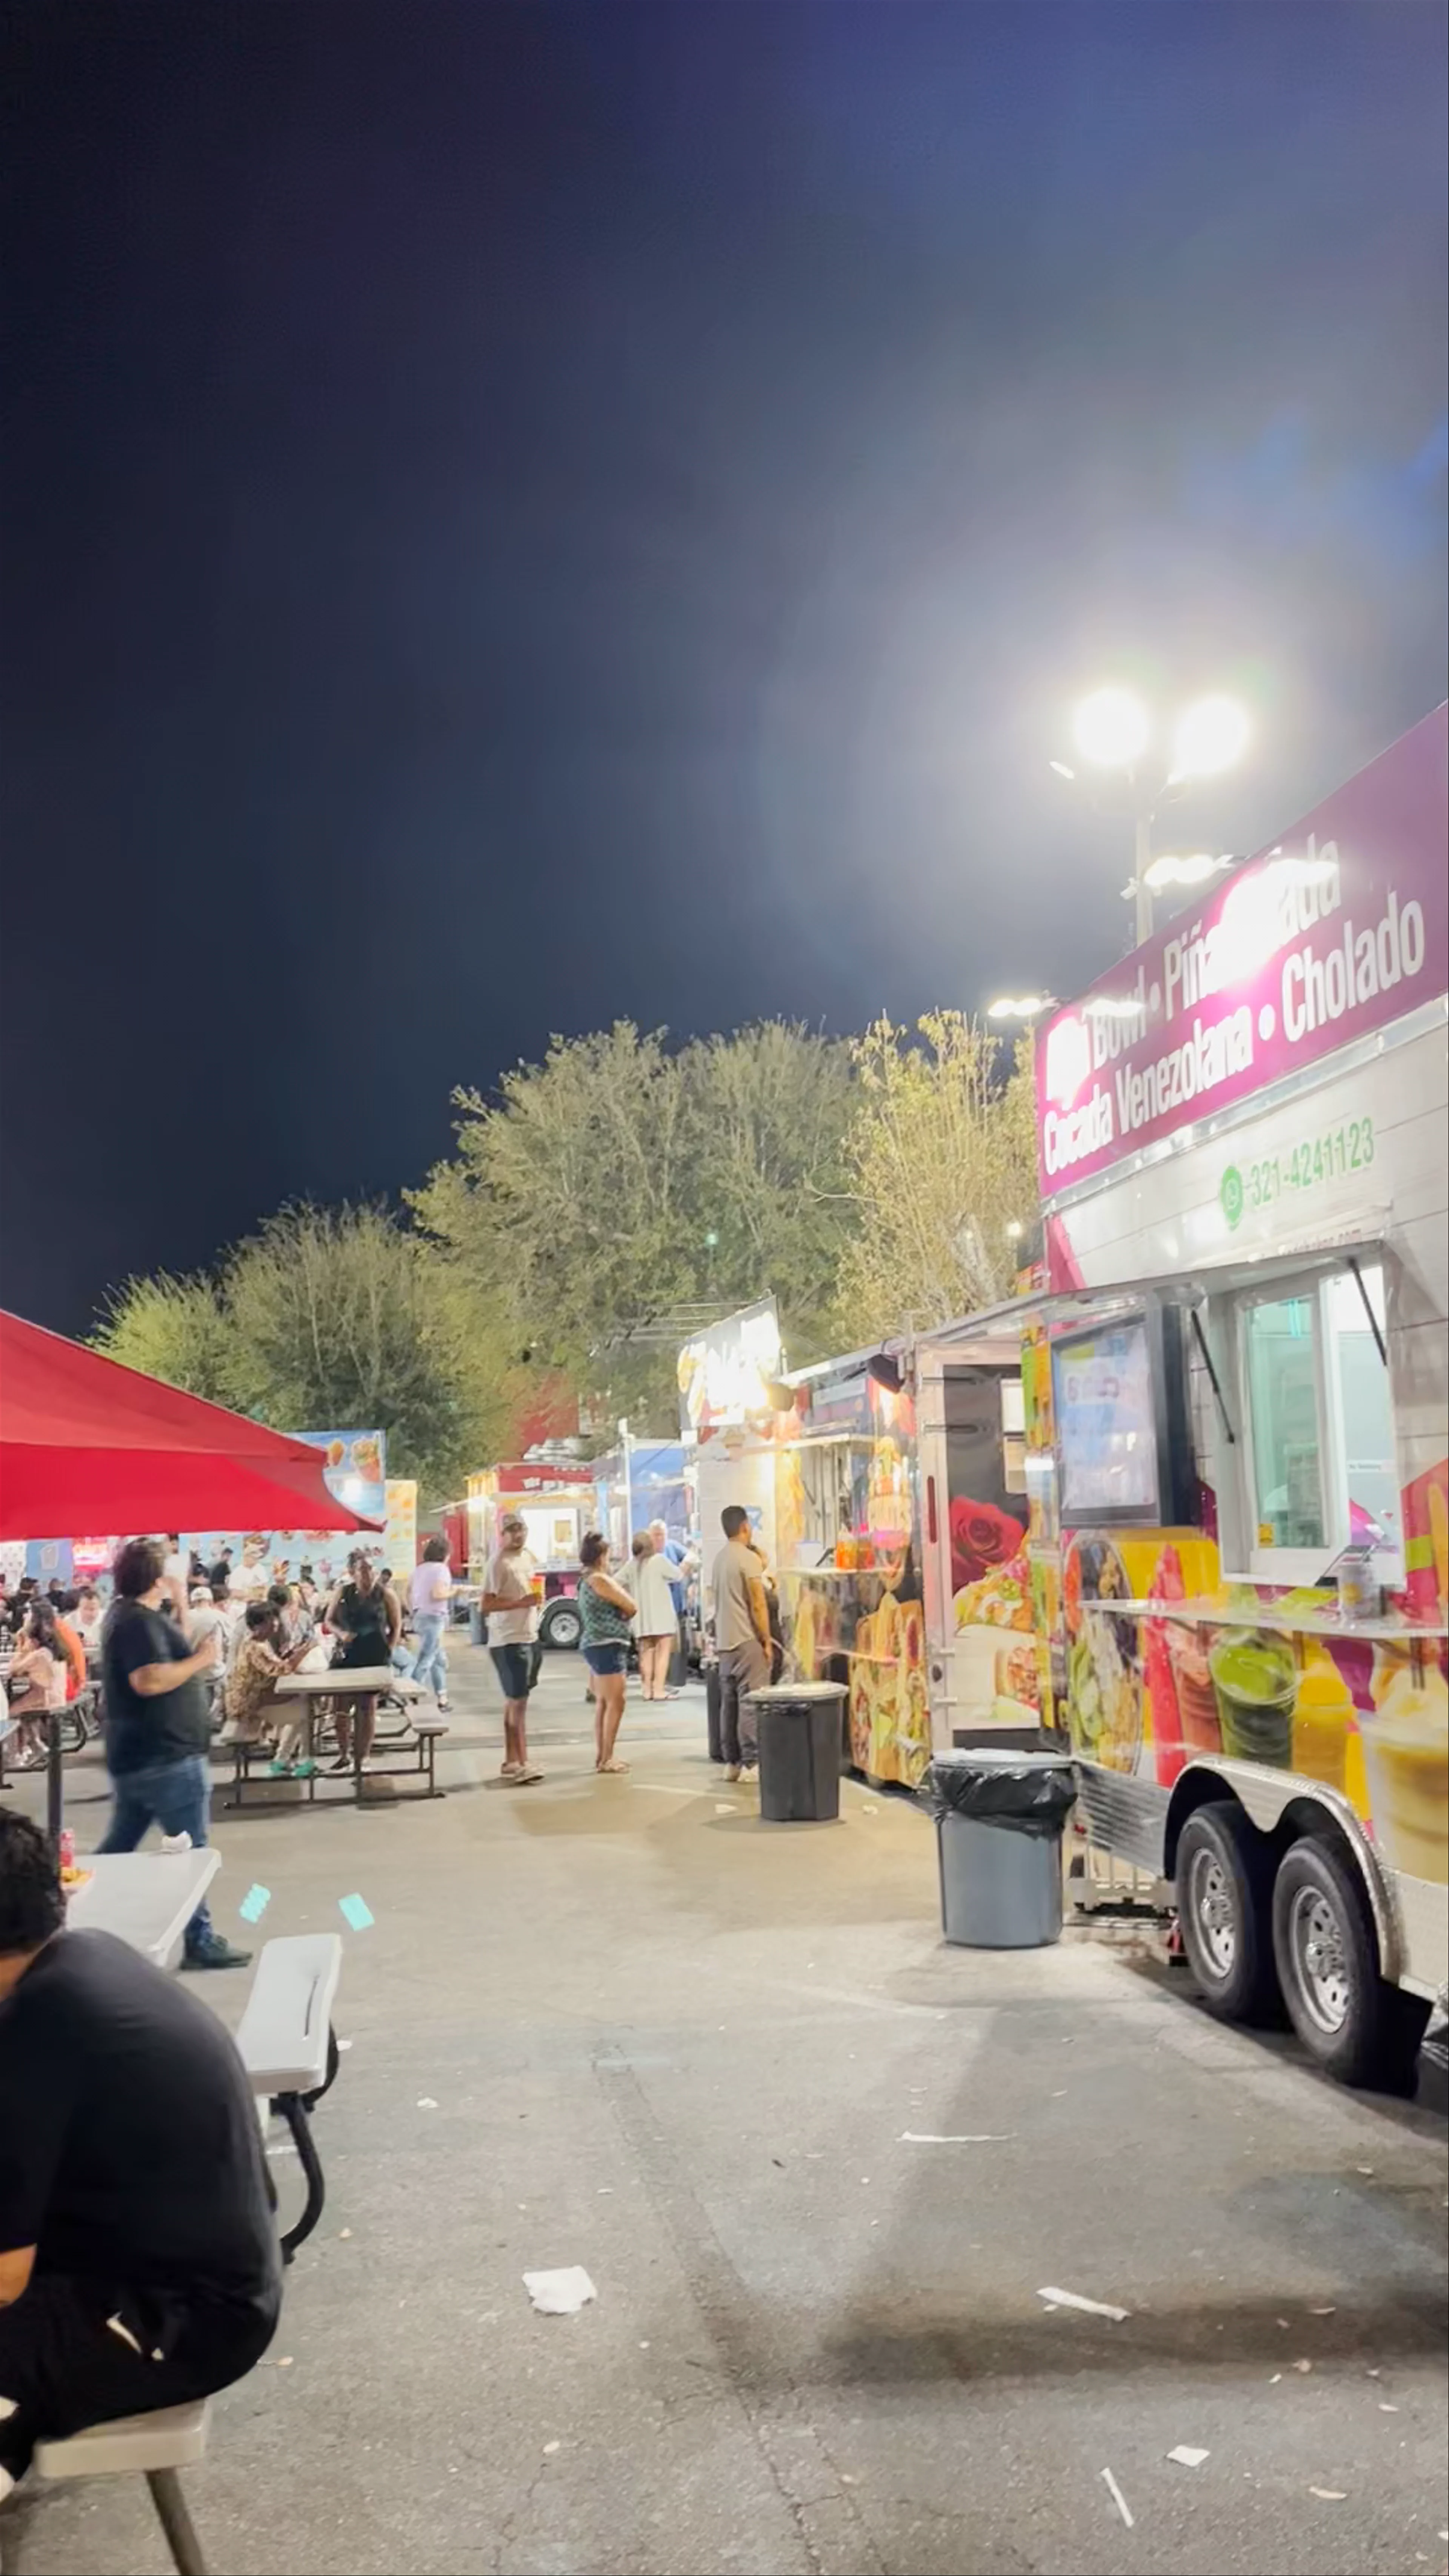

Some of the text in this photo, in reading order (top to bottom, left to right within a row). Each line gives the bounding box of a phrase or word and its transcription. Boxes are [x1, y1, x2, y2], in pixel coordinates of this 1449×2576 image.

[1093, 965, 1146, 1070] Bowl
[1116, 1006, 1253, 1135] Venezolana
[1282, 890, 1425, 1042] Cholado
